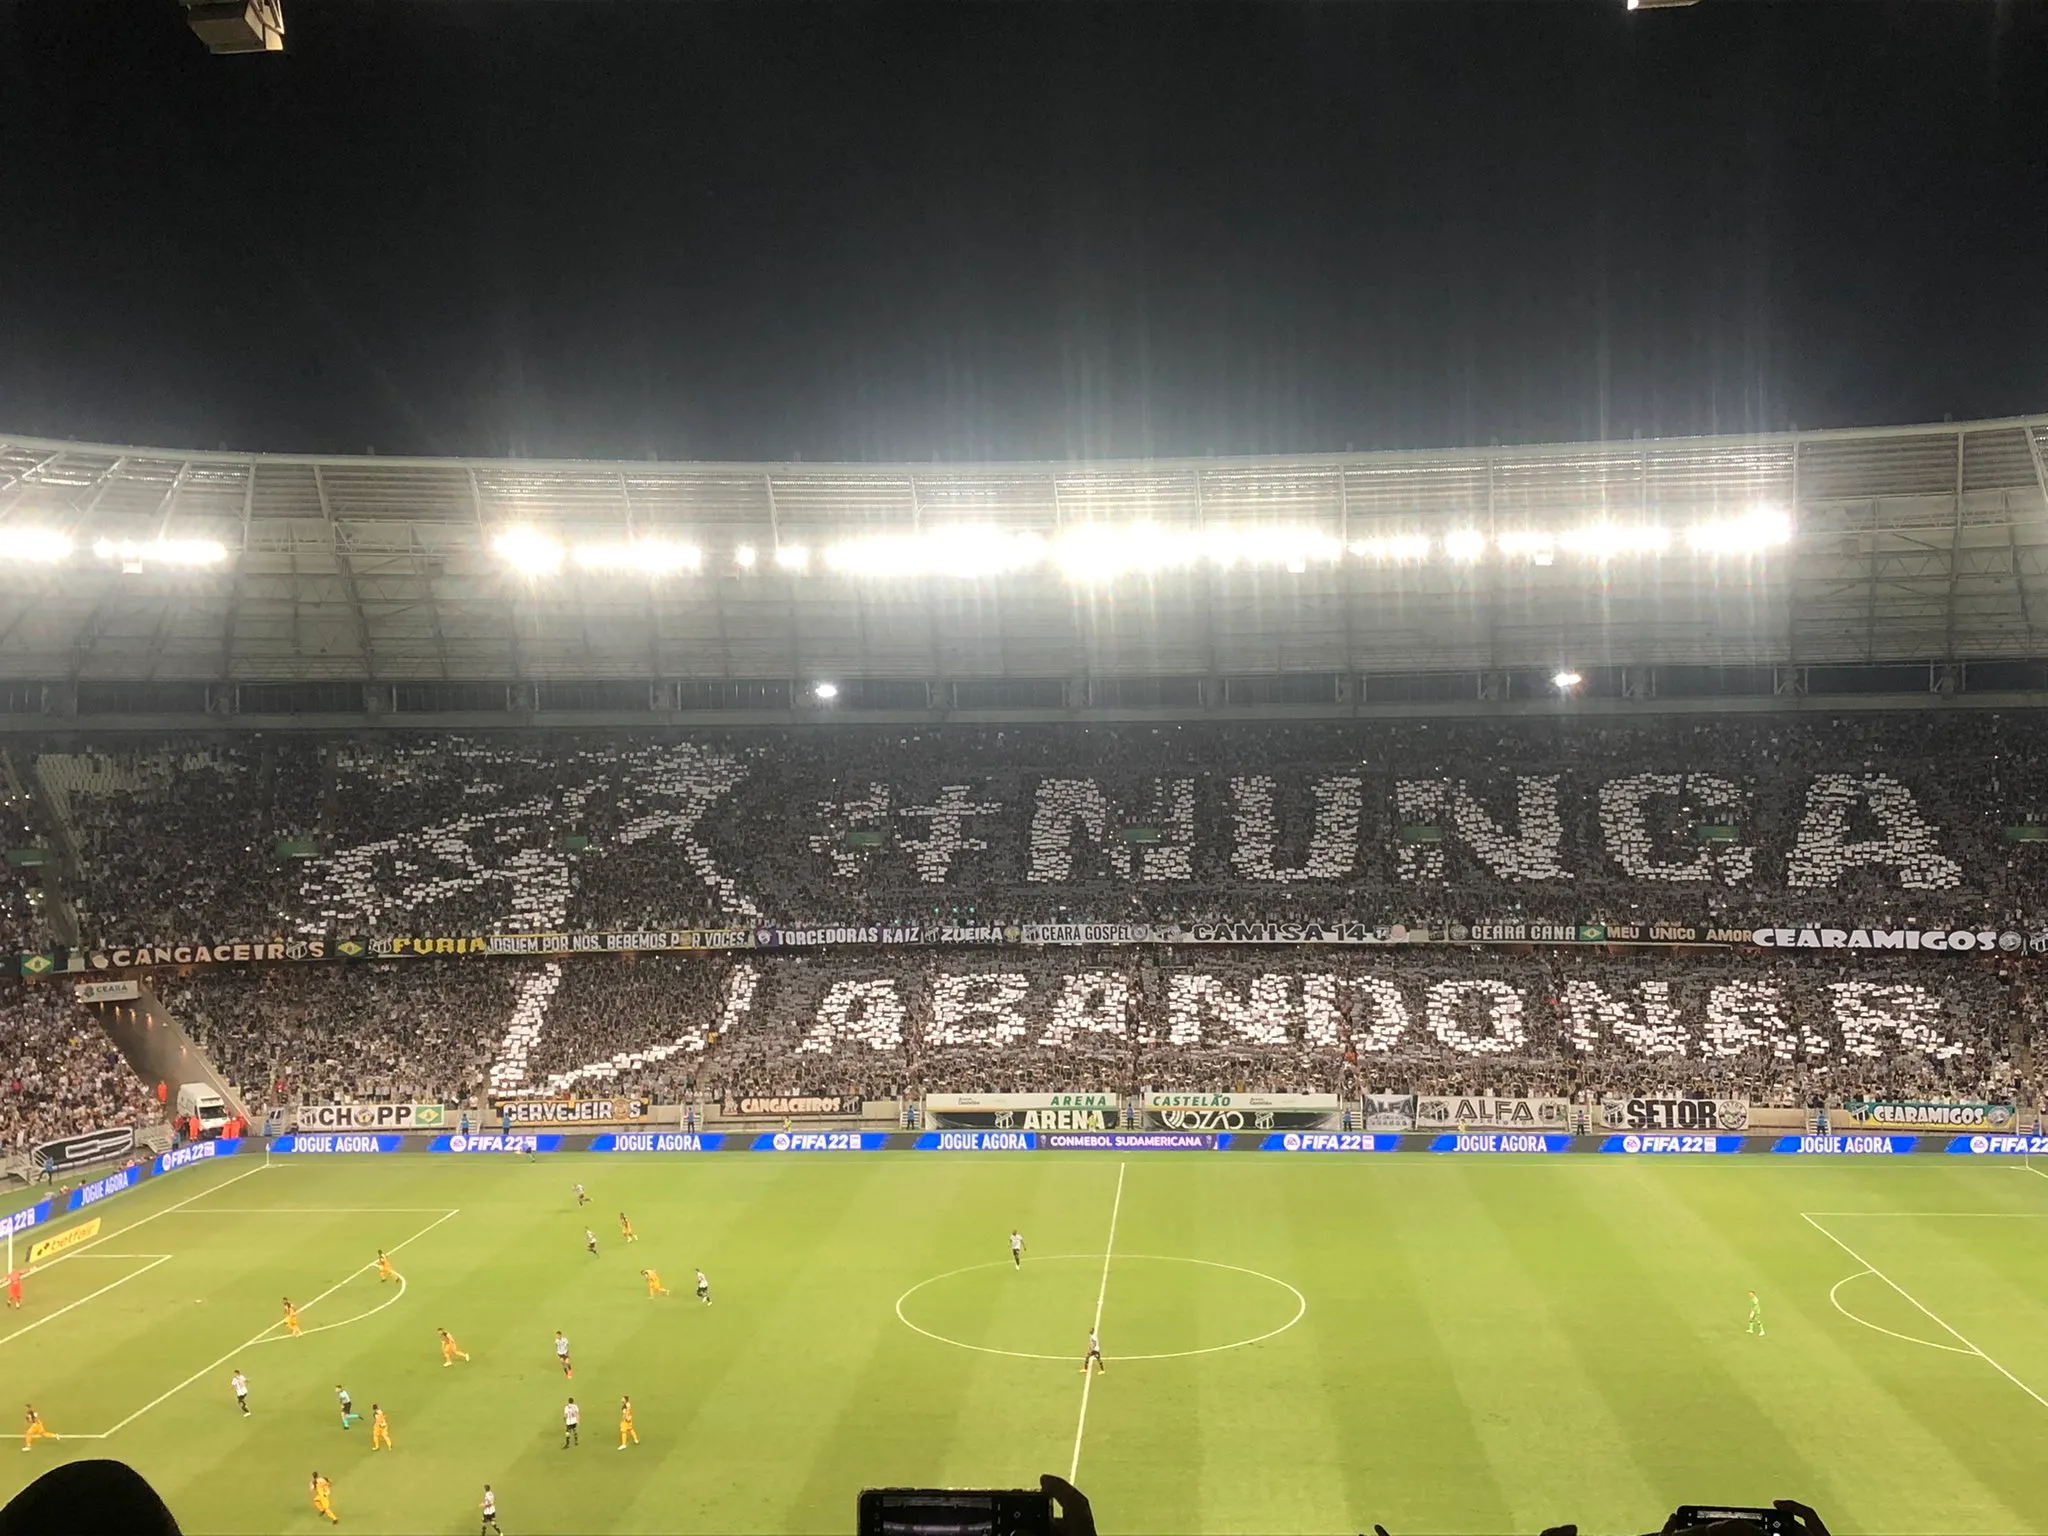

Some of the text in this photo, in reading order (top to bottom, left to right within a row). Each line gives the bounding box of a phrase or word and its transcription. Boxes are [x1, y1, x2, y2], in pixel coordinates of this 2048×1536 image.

[775, 926, 878, 946] TORCEDORAS
[940, 926, 1003, 942] ZUEIRA
[1085, 926, 1130, 941] GOSPEL
[1193, 923, 1367, 941] CAMISA 14
[1531, 925, 1576, 940] CANA
[1607, 926, 1640, 939] MEU
[1706, 928, 1752, 943] AMOR
[1752, 928, 1997, 950] CEARAMIGOS
[392, 936, 486, 954] FURIA
[487, 936, 538, 952] JOGUEM
[543, 935, 569, 951] POR
[607, 932, 667, 950] BEBEMOS
[741, 1096, 840, 1113] CANGACEIROS
[1051, 1095, 1107, 1106] ARENA
[1153, 1094, 1231, 1106] CASTELÃO
[1363, 1097, 1413, 1116] ALFA
[1455, 1099, 1534, 1121] ALFA
[1627, 1100, 1717, 1129] SETOR
[1873, 1105, 1984, 1125] CEARAMIGOS
[1023, 1109, 1106, 1130] ARENA
[291, 1136, 379, 1153] JOGUE AGORA
[468, 1136, 523, 1151] FIFA 22
[612, 1135, 702, 1151] JOGUE AGORA
[791, 1134, 849, 1150] FIFA 22
[937, 1133, 1027, 1150] JOGUE AGORA
[1050, 1135, 1202, 1147] CONMEBOL SUDAMERICANA
[1302, 1135, 1361, 1150] FIFA 22
[1453, 1135, 1548, 1151] JOGUE AGORA
[1642, 1136, 1704, 1152] FIFA 22
[1797, 1136, 1893, 1153] JOGUE AGORA
[1989, 1137, 2029, 1152] FIFA
[171, 1143, 204, 1169] FIFA 22
[81, 1171, 129, 1206] JOGUE AGORA
[14, 1210, 27, 1231] 22
